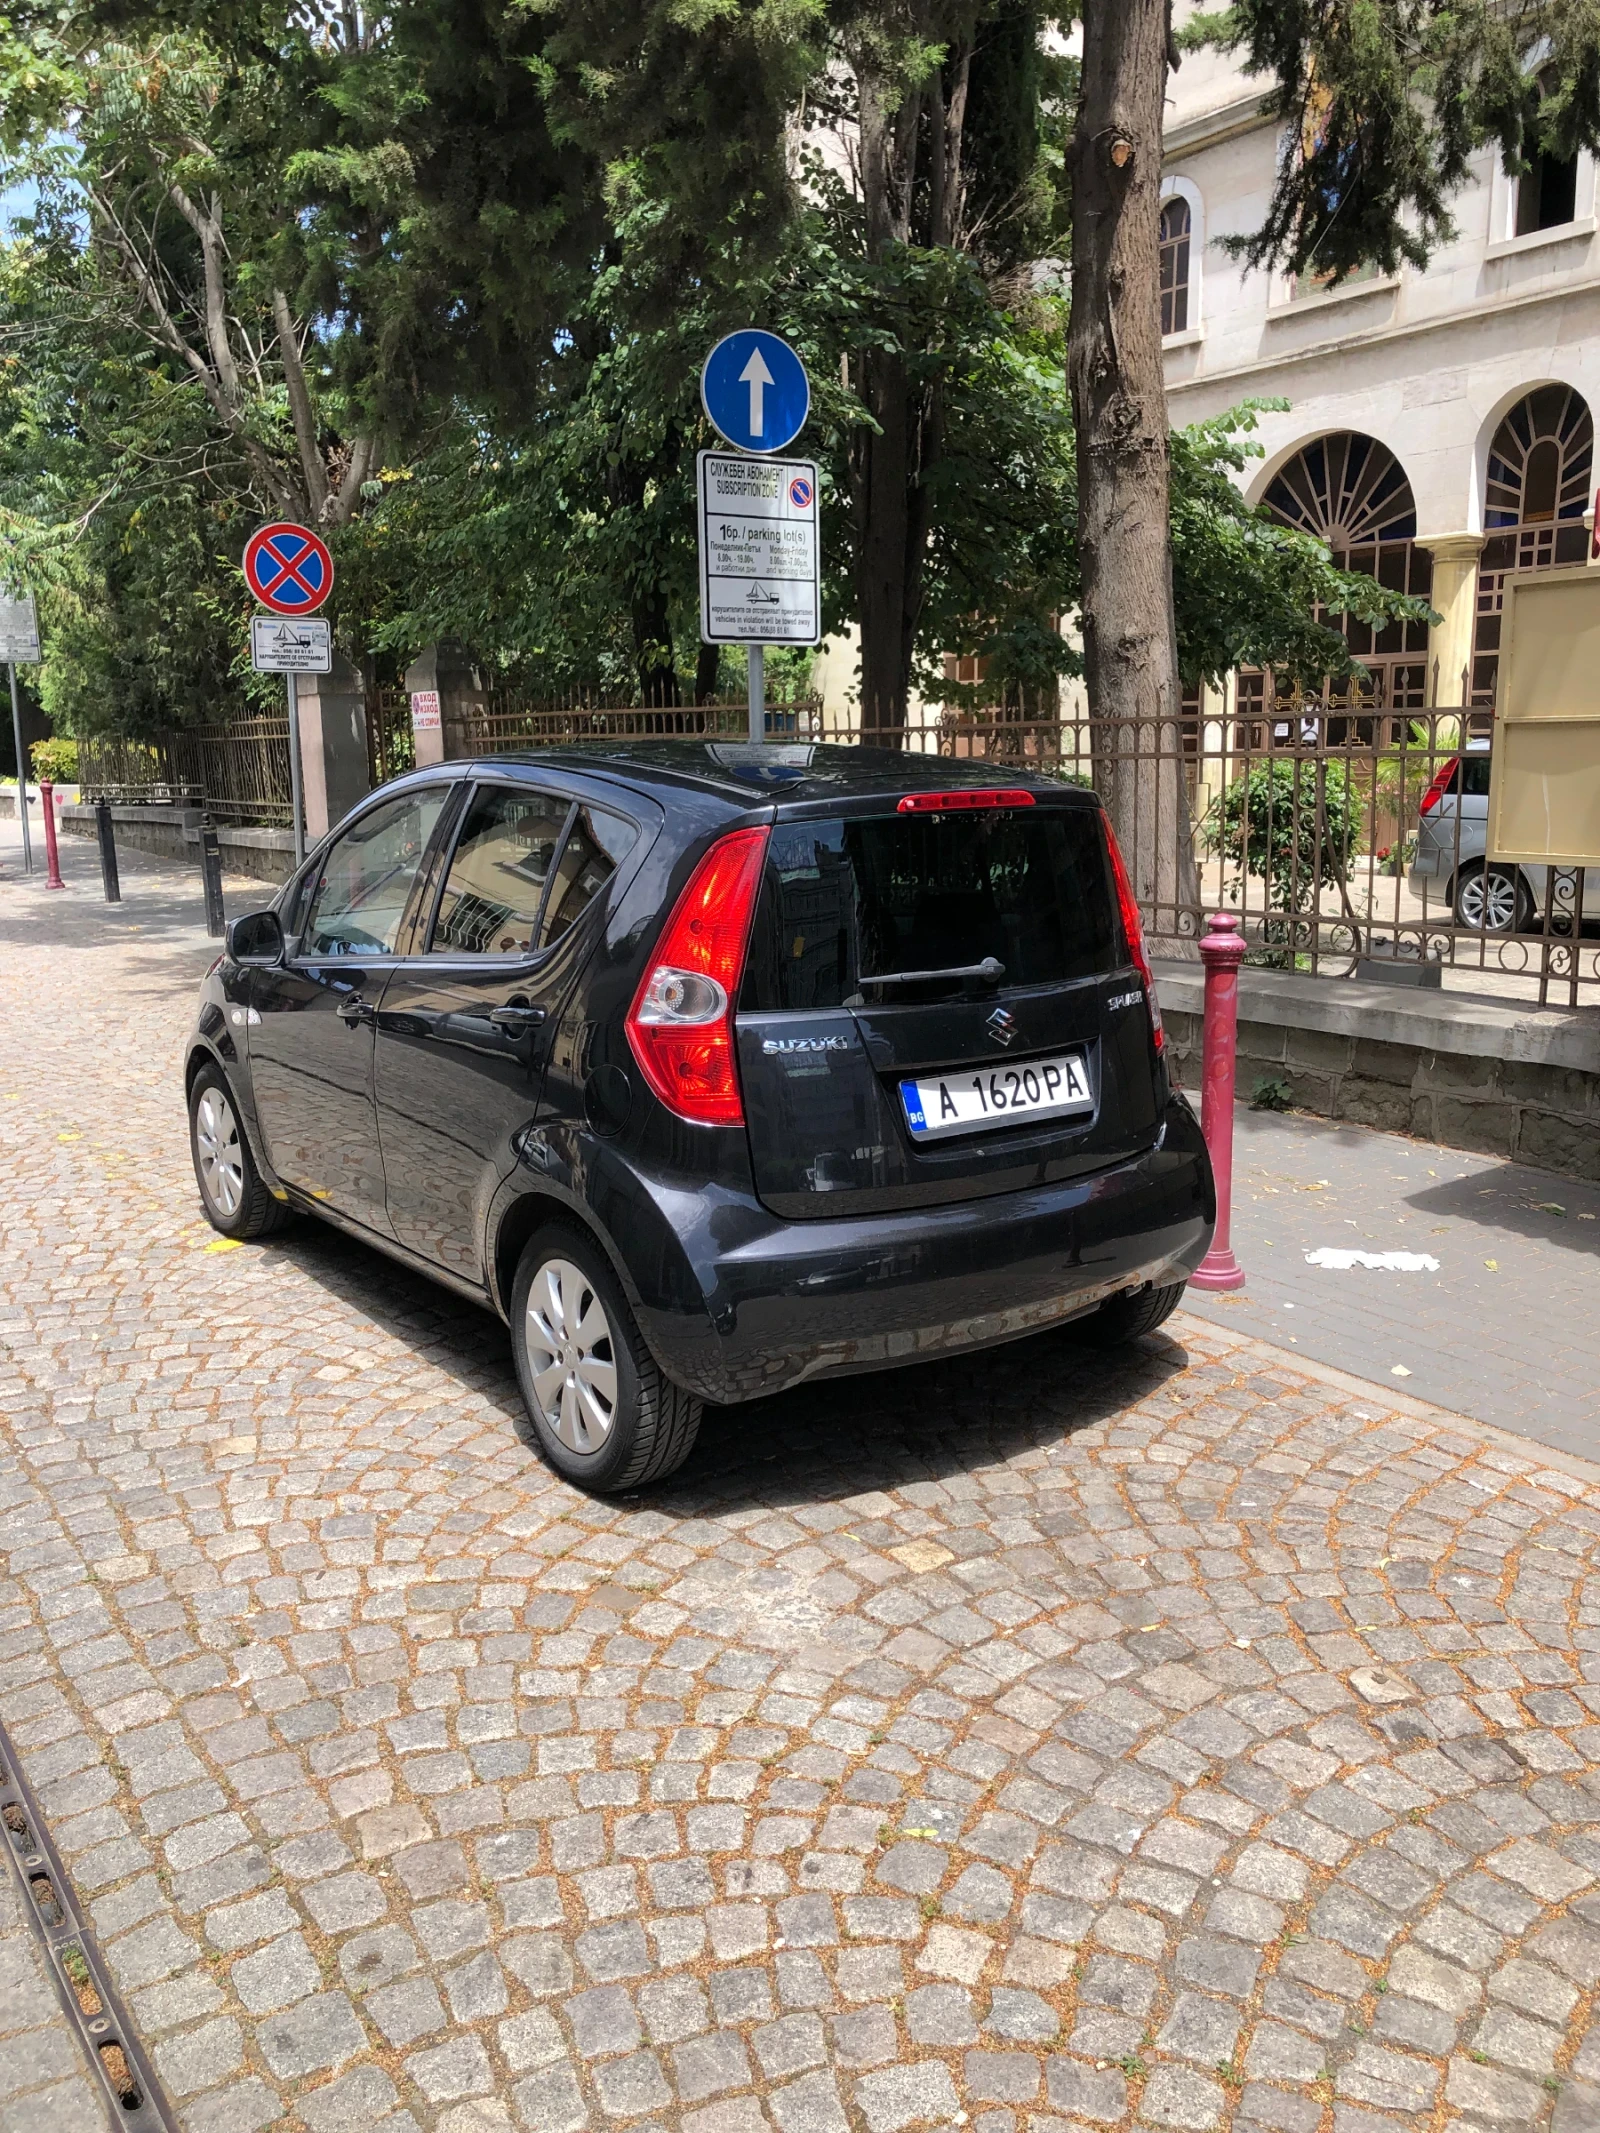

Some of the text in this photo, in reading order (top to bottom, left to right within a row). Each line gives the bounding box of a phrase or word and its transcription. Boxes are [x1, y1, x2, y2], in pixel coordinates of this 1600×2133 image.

[710, 462, 783, 482] СЛУЖЕБЕН АБОНАМЕНТ
[717, 480, 778, 498] SUBSCRIPTION ZONE
[748, 528, 780, 544] parking
[784, 529, 806, 545] lot(s)
[769, 544, 808, 557] Monday-Friday
[721, 563, 744, 573] работни
[746, 566, 756, 574] дни
[766, 566, 812, 578] and working days
[714, 615, 736, 623] vehicles
[743, 616, 764, 624] violation
[774, 617, 782, 625] be
[798, 620, 810, 628] away
[420, 693, 436, 703] ВХОД
[420, 704, 438, 714] ИЗХОД
[762, 1036, 848, 1055] SUZUKI
[910, 1111, 924, 1125] BG
[54, 1939, 77, 1952] ACO
